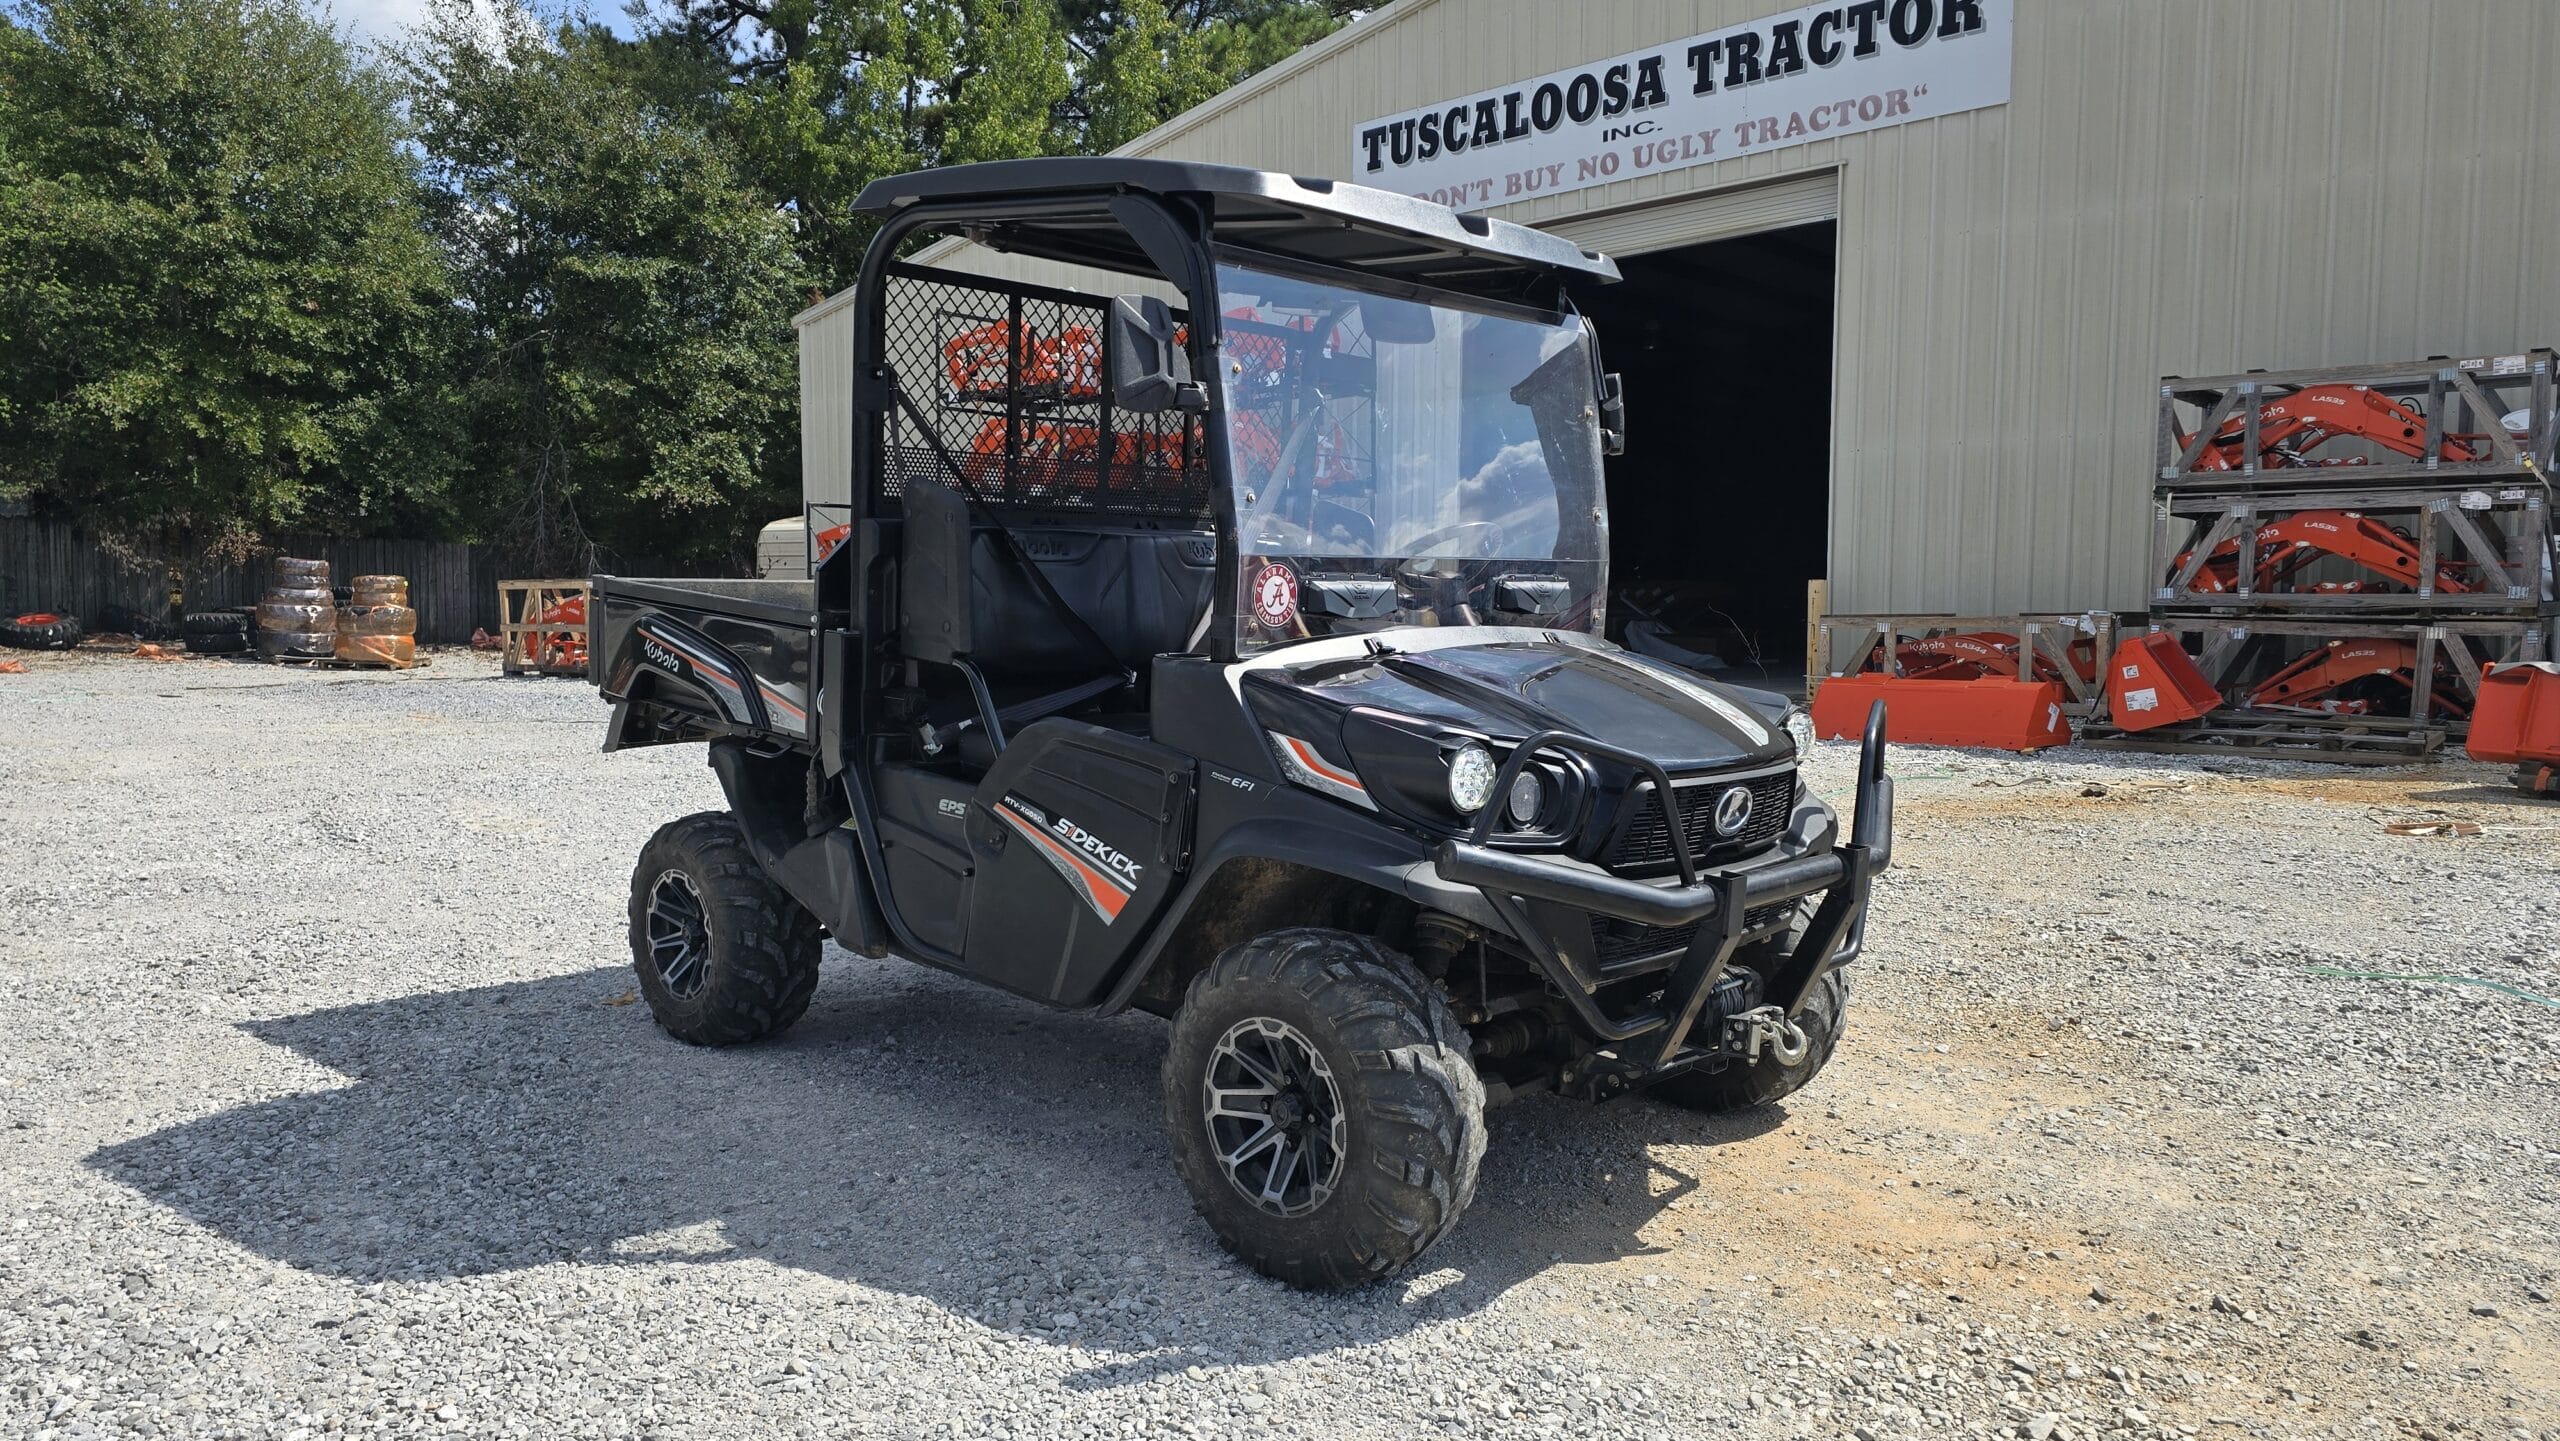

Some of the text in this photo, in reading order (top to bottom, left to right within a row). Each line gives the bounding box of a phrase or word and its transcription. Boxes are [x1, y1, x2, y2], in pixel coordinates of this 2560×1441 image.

[1362, 0, 1985, 173] TUSCALOOSA TRACTOR
[1602, 119, 1663, 143] INC.
[1504, 162, 1566, 197] BUY
[1577, 151, 1620, 182] NO
[1632, 128, 1721, 169] UGLY
[2311, 395, 2347, 406] LA535
[2304, 522, 2340, 532] LA535
[1256, 567, 1295, 594] ALABAMA
[1266, 582, 1284, 608] A
[1256, 598, 1296, 624] CRIMSON TIDE
[643, 638, 680, 673] Kubota
[1909, 641, 1988, 655] Kubota LA344
[2341, 650, 2376, 659] LA535
[1231, 777, 1255, 791] EFI
[939, 799, 966, 815] EPS
[1052, 817, 1143, 881] SIDEKICK
